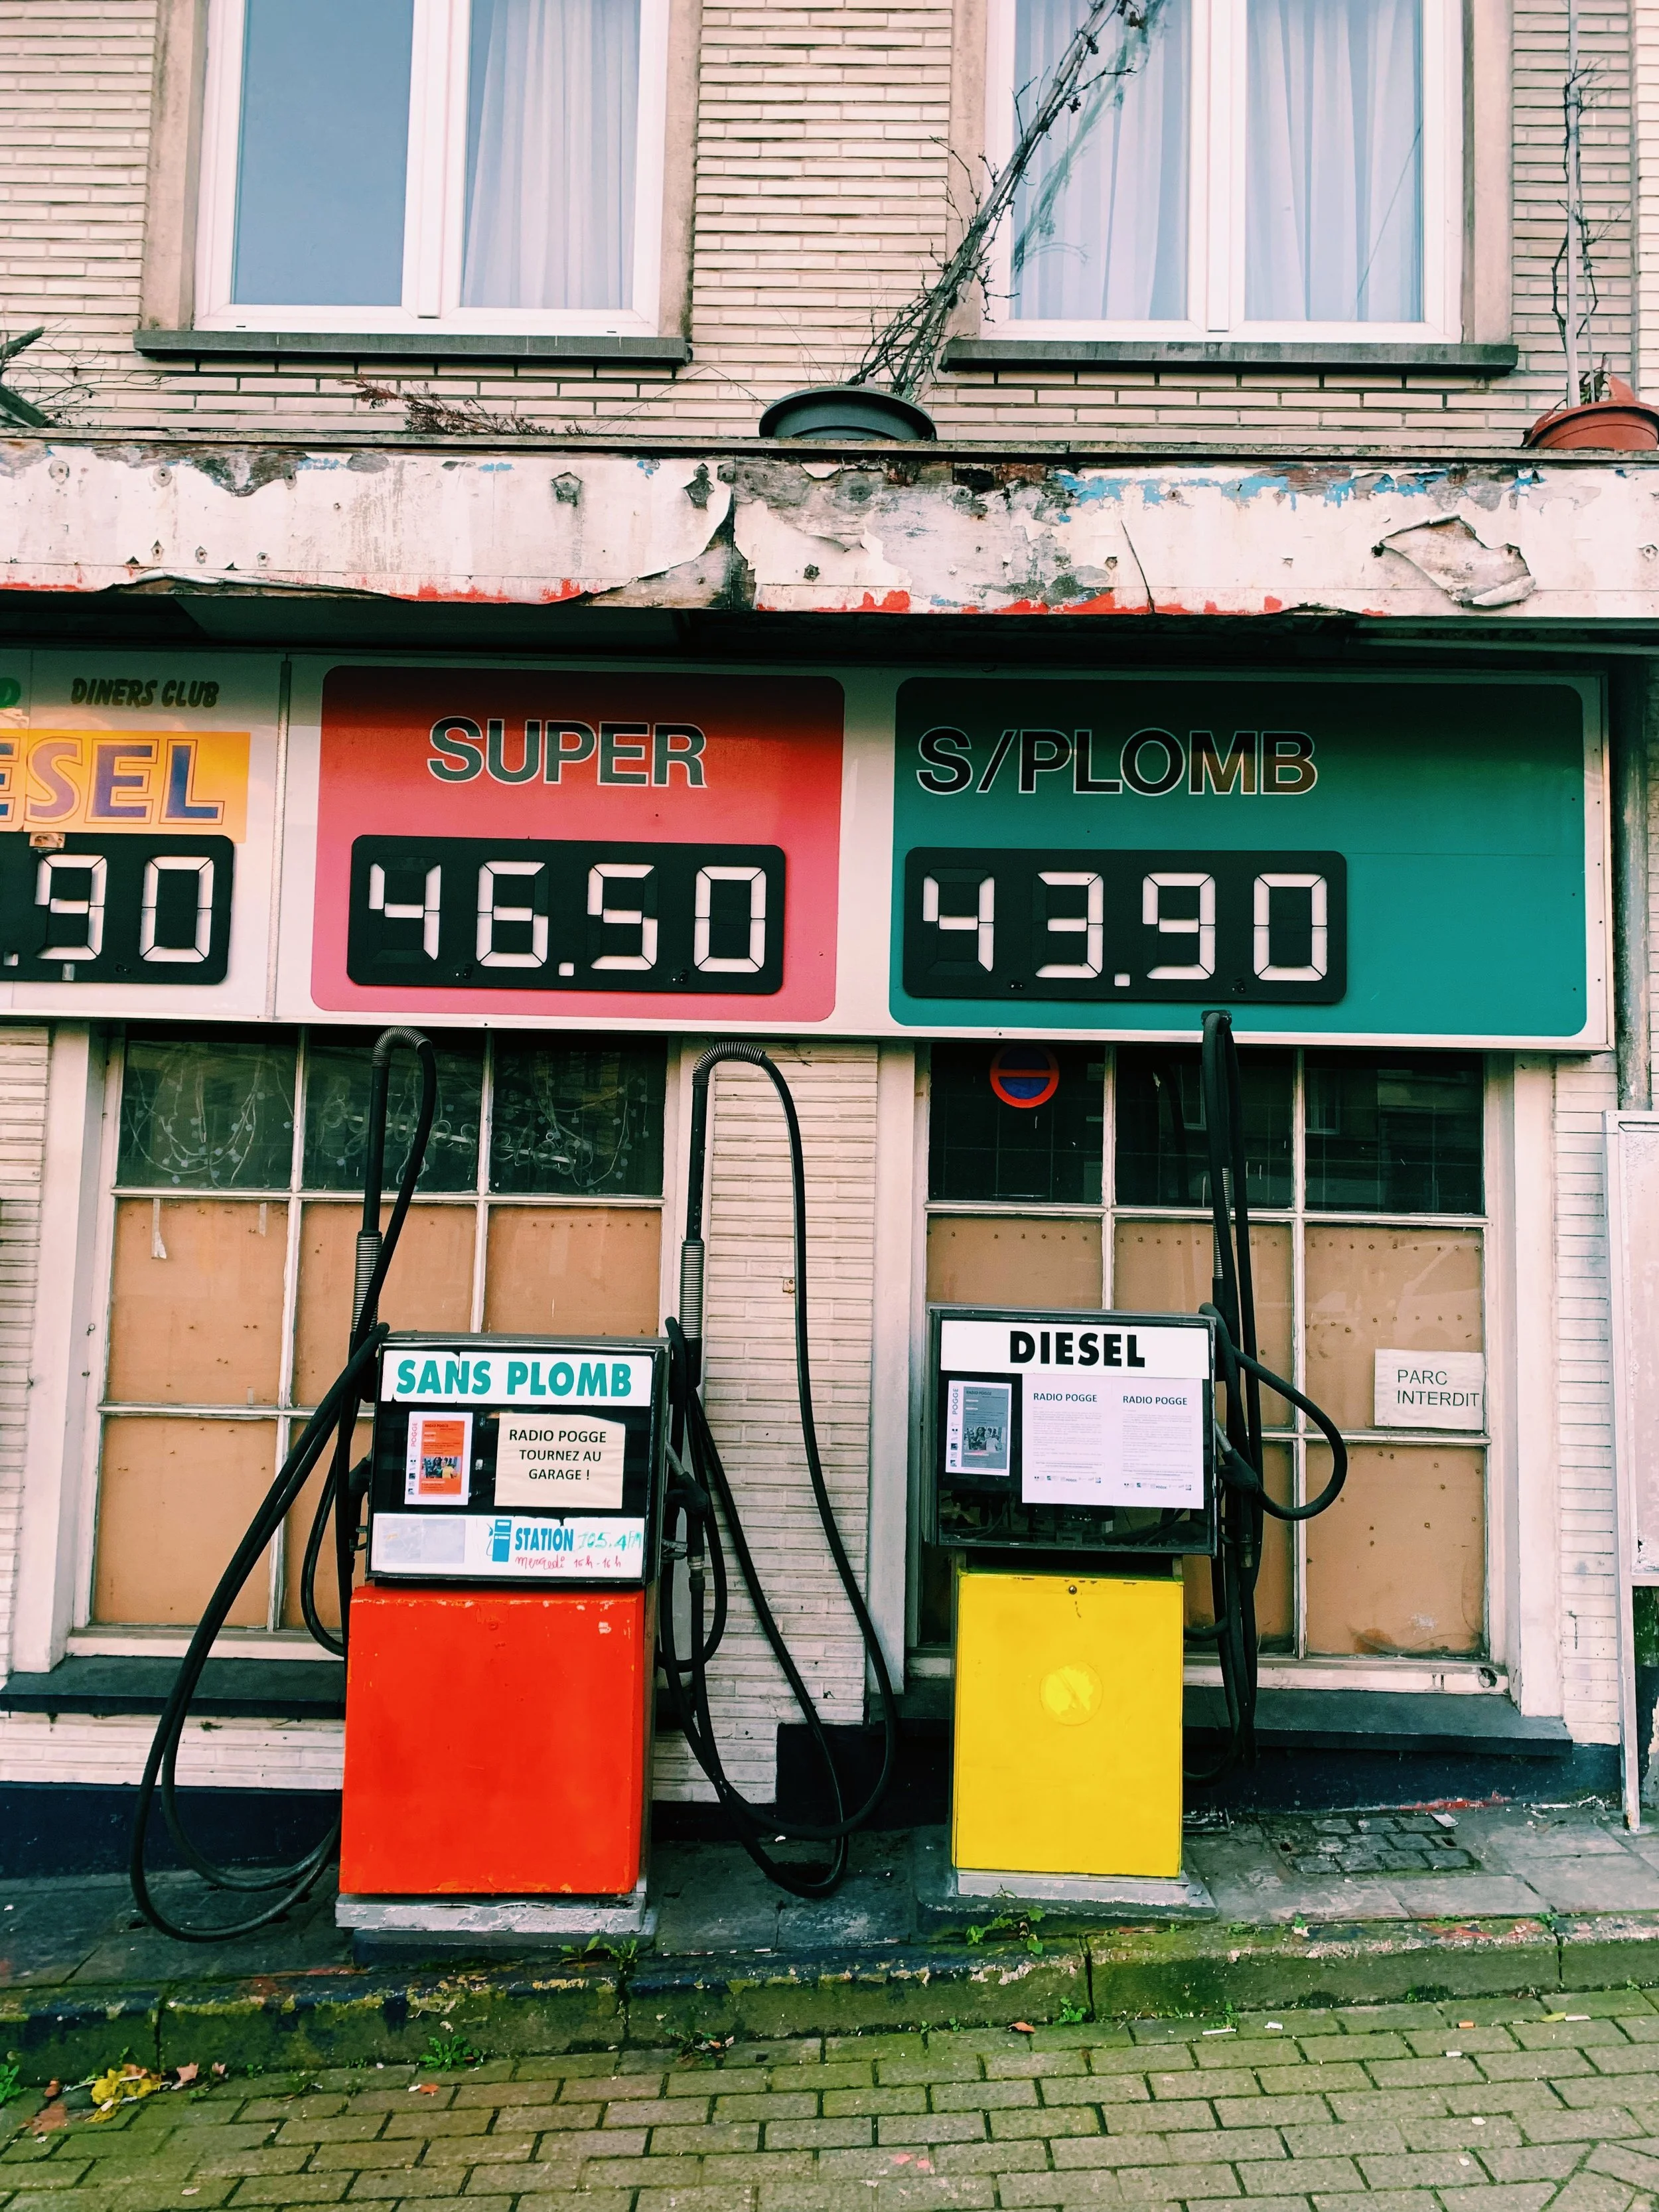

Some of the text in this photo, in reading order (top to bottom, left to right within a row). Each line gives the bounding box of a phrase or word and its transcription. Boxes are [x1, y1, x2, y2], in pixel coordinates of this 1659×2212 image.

[71, 678, 220, 708] DINERS CLUB
[427, 715, 707, 788] SUPER
[916, 727, 1318, 796] S/PLOMB
[369, 861, 766, 976] 46.50
[922, 871, 1327, 986] 43.90
[1010, 1331, 1145, 1368] DIESEL
[396, 1359, 632, 1397] SANS PLOMB
[1398, 1369, 1448, 1385] PARC
[1033, 1392, 1097, 1402] RADIO POGGE
[1397, 1390, 1480, 1407] INTERDIT
[509, 1429, 607, 1443] RADIO POGGE
[520, 1449, 601, 1461] TOURNEZ AU
[529, 1469, 581, 1480] GARAGE
[515, 1528, 574, 1552] STATION
